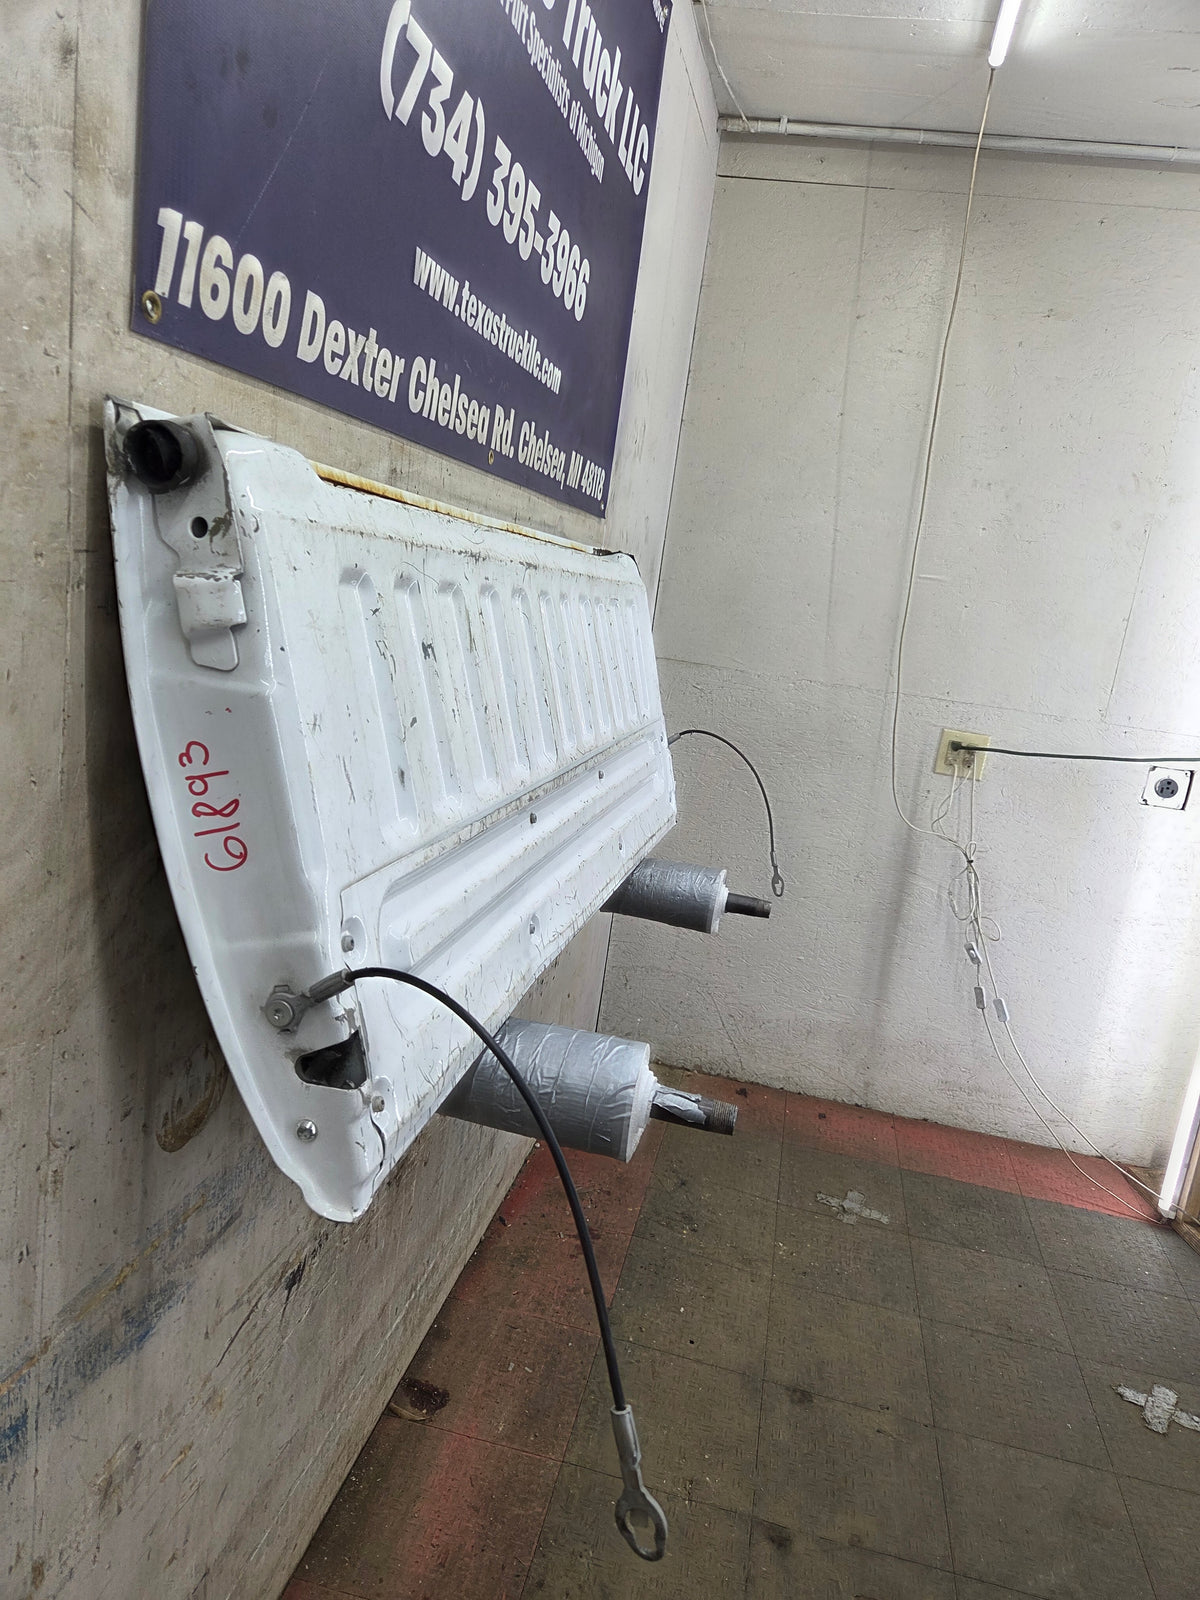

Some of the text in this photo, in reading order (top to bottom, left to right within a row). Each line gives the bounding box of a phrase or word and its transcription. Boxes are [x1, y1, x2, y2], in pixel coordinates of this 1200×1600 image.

[380, 0, 590, 321] (734) 395-3966
[527, 11, 571, 119] Specialists
[569, 100, 581, 135] of
[576, 106, 605, 184] Michigan
[618, 86, 649, 195] LLC
[154, 207, 606, 501] 11600 Dexter Chelsea Rd. Chelsea, MI 48118
[413, 246, 562, 394] www.texastruckllc.com
[178, 740, 249, 872] 61893
